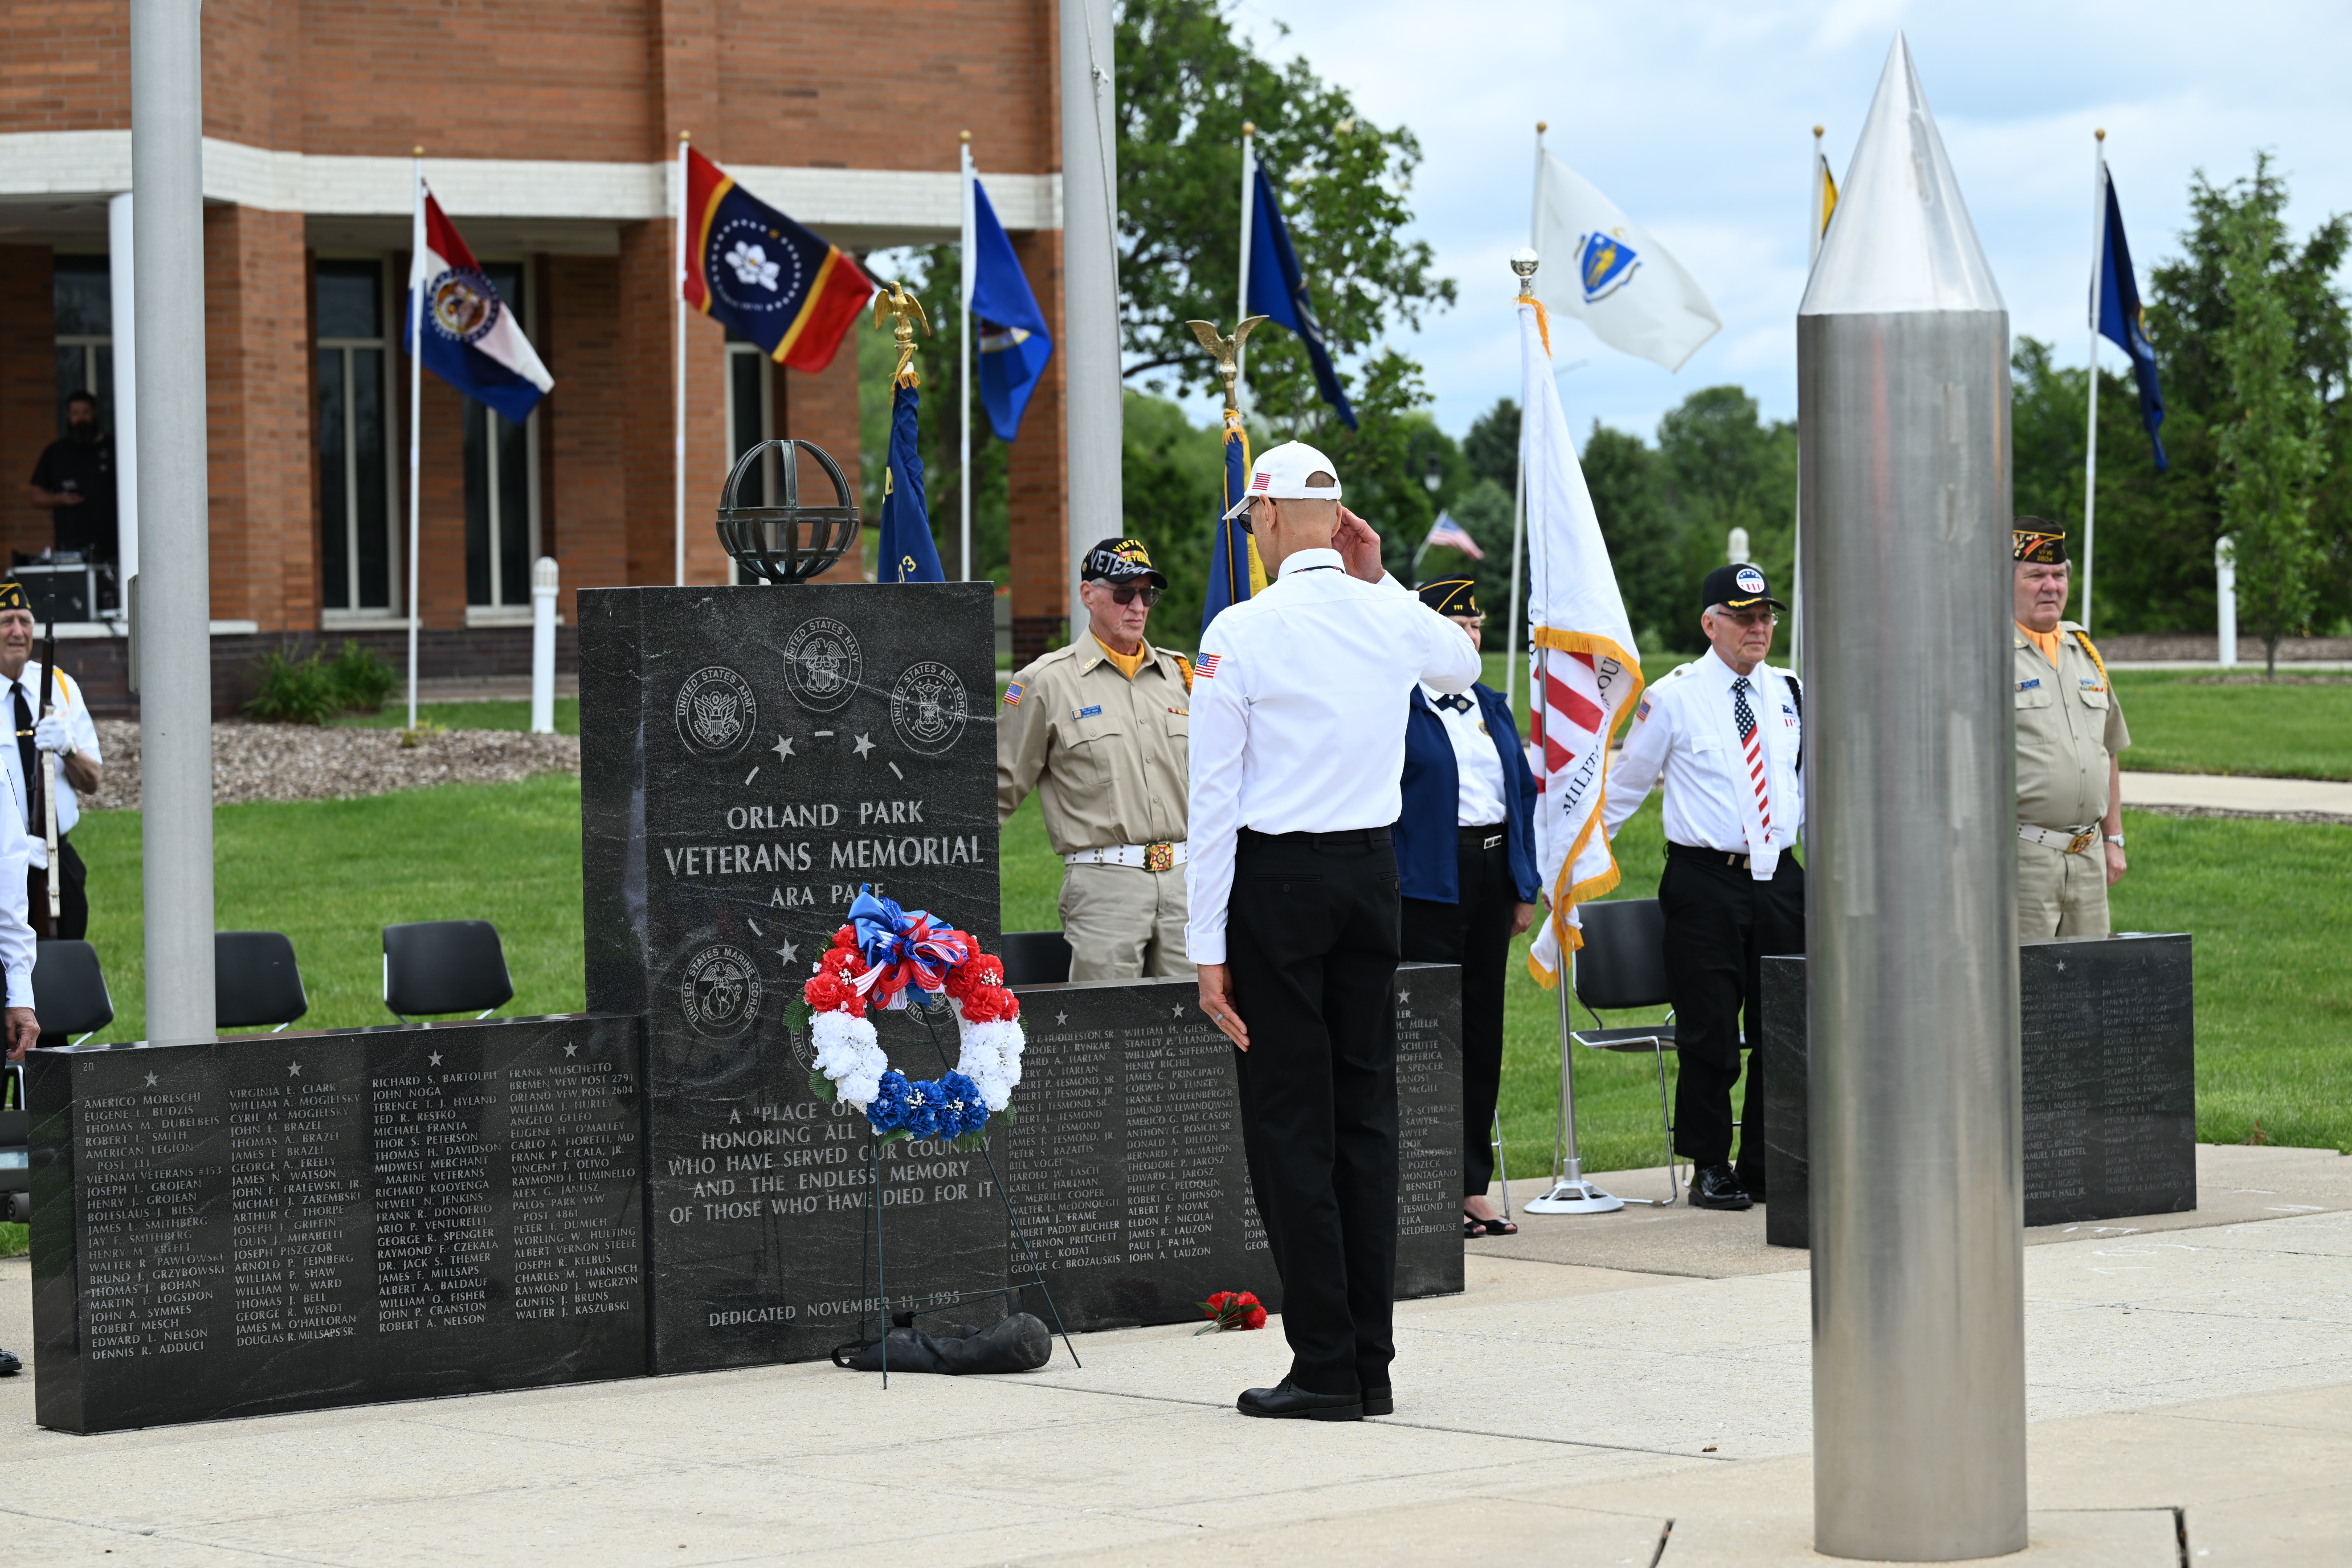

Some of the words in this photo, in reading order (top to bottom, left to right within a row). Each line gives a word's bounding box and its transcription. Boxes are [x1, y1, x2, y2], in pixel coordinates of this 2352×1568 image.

[786, 628, 806, 664] UNITED
[810, 620, 843, 634] STATES
[845, 635, 859, 663] NAVY
[679, 679, 697, 716] UNITED
[701, 670, 737, 683] STATES
[738, 685, 754, 713] ARMY
[893, 685, 904, 725] UNITED
[904, 664, 936, 683] STATES
[940, 669, 955, 684] AIR
[954, 685, 965, 723] FORCE
[727, 804, 839, 830] ORLAND
[860, 801, 923, 825] PARK
[664, 842, 811, 876] VETERANS
[830, 835, 984, 869] MEMORIAL
[770, 886, 815, 906] ARA
[688, 948, 719, 976] STATES
[724, 948, 756, 977] MARINE
[684, 983, 699, 1023] UNITED
[744, 982, 759, 1020] CORPS
[729, 1108, 741, 1124] A
[754, 1103, 817, 1121] "PLACE
[702, 1126, 810, 1150] HONORING
[824, 1123, 856, 1140] ALL
[668, 1157, 716, 1176] WHO
[727, 1153, 772, 1171] HAVE
[783, 1148, 847, 1167] SERVED
[859, 1143, 897, 1161] OUR
[2059, 1148, 2086, 1157] KRESTEL
[693, 1179, 735, 1198] AND
[750, 1175, 785, 1193] THE
[799, 1167, 876, 1189] ENDLESS
[891, 1161, 969, 1182] MEMORY
[1406, 1181, 1442, 1191] BENNETT
[669, 1206, 693, 1223] OF
[704, 1201, 762, 1220] THOSE
[771, 1197, 818, 1215] WHO
[828, 1192, 872, 1210] HAVE
[883, 1187, 924, 1206] DIED
[935, 1183, 968, 1202] FOR
[979, 1181, 993, 1198] IT
[1412, 1193, 1432, 1202] BELL,
[1438, 1191, 1448, 1200] JR.
[1128, 1205, 1159, 1216] ALBERT
[1165, 1204, 1172, 1212] P.
[1178, 1201, 1208, 1211] NOVAK
[1402, 1202, 1443, 1213] TESMOND
[1128, 1216, 1158, 1227] ELDON
[1165, 1215, 1170, 1224] F.
[1177, 1212, 1214, 1223] NICOLAI
[1401, 1223, 1456, 1235] KELDERHOUSE
[1010, 1241, 1019, 1250] A.
[1026, 1237, 1063, 1249] VERNON
[1069, 1232, 1117, 1245] PRITCHETT
[1129, 1228, 1154, 1240] JAMES
[1160, 1227, 1169, 1236] R.
[1174, 1223, 1211, 1235] LAUZON
[1045, 1250, 1052, 1259] E.
[1059, 1246, 1089, 1257] KODAT
[1052, 1260, 1060, 1269] C.
[1065, 1254, 1120, 1268] BROZAUSKIS
[1129, 1252, 1153, 1263] JOHN
[1159, 1250, 1168, 1259] A.
[1174, 1246, 1210, 1258] LAUZON
[514, 1259, 551, 1272] JOSEPH
[558, 1257, 567, 1267] R.
[574, 1253, 611, 1265] KELBUS
[235, 1271, 281, 1284] WILLIAM
[288, 1270, 297, 1279] P.
[304, 1267, 336, 1278] SHAW
[378, 1272, 409, 1284] JAMES
[416, 1271, 424, 1280] F.
[431, 1265, 479, 1279] MILLSAPS
[514, 1271, 559, 1283] CHARLES
[566, 1269, 578, 1279] M.
[585, 1264, 637, 1277] HARNISCH
[89, 1284, 138, 1297] THOMAS
[145, 1283, 152, 1294] J.
[160, 1279, 201, 1291] BOHAN
[235, 1284, 281, 1297] WILLIAM
[289, 1282, 303, 1292] W.
[310, 1279, 342, 1290] WARD
[378, 1284, 415, 1296] ALBERT
[423, 1282, 433, 1292] A.
[440, 1277, 488, 1290] BALDAUF
[514, 1282, 568, 1296] RAYMOND
[575, 1281, 581, 1292] J.
[588, 1276, 638, 1289] WEGRZYN
[90, 1297, 133, 1310] MARTIN
[157, 1290, 213, 1304] LOGSDON
[235, 1296, 281, 1309] THOMAS
[289, 1295, 295, 1306] J.
[303, 1292, 326, 1303] BELL
[379, 1296, 424, 1308] WILLIAM
[431, 1294, 444, 1304] O.
[450, 1290, 485, 1302] FISHER
[516, 1296, 554, 1308] GUNTIS
[561, 1295, 567, 1305] J.
[574, 1291, 608, 1302] BRUNS
[709, 1305, 797, 1326] DEDICATED
[807, 1297, 890, 1317] NOVEMBER
[901, 1295, 919, 1310] 11,
[929, 1291, 960, 1306] 1995
[91, 1310, 121, 1324] JOHN
[129, 1309, 140, 1319] A.
[148, 1304, 191, 1317] SYMMES
[236, 1309, 280, 1321] GEORGE
[287, 1307, 297, 1317] R.
[304, 1303, 344, 1315] WENDT
[379, 1309, 407, 1321] JOHN
[415, 1307, 423, 1317] P.
[430, 1301, 486, 1316] CRANSTON
[516, 1308, 554, 1320] WALTER
[561, 1306, 568, 1317] J.
[575, 1301, 629, 1314] KASZUBSKI
[91, 1322, 134, 1334] ROBERT
[141, 1318, 178, 1330] MESCH
[236, 1322, 267, 1336] JAMES
[271, 1321, 283, 1331] M.
[288, 1314, 356, 1329] O'HALLORAN
[379, 1320, 419, 1332] ROBERT
[426, 1318, 436, 1328] A.
[443, 1314, 484, 1326] NELSON
[92, 1334, 140, 1348] EDWARD
[148, 1333, 156, 1342] L.
[164, 1328, 208, 1341] NELSON
[236, 1333, 284, 1346] DOUGLAS
[287, 1332, 296, 1342] R.
[299, 1328, 341, 1341] MILLSAPS
[342, 1326, 356, 1337] SR.
[92, 1347, 134, 1360] DENNIS
[141, 1345, 152, 1355] R.
[159, 1341, 204, 1354] ADDUCI
